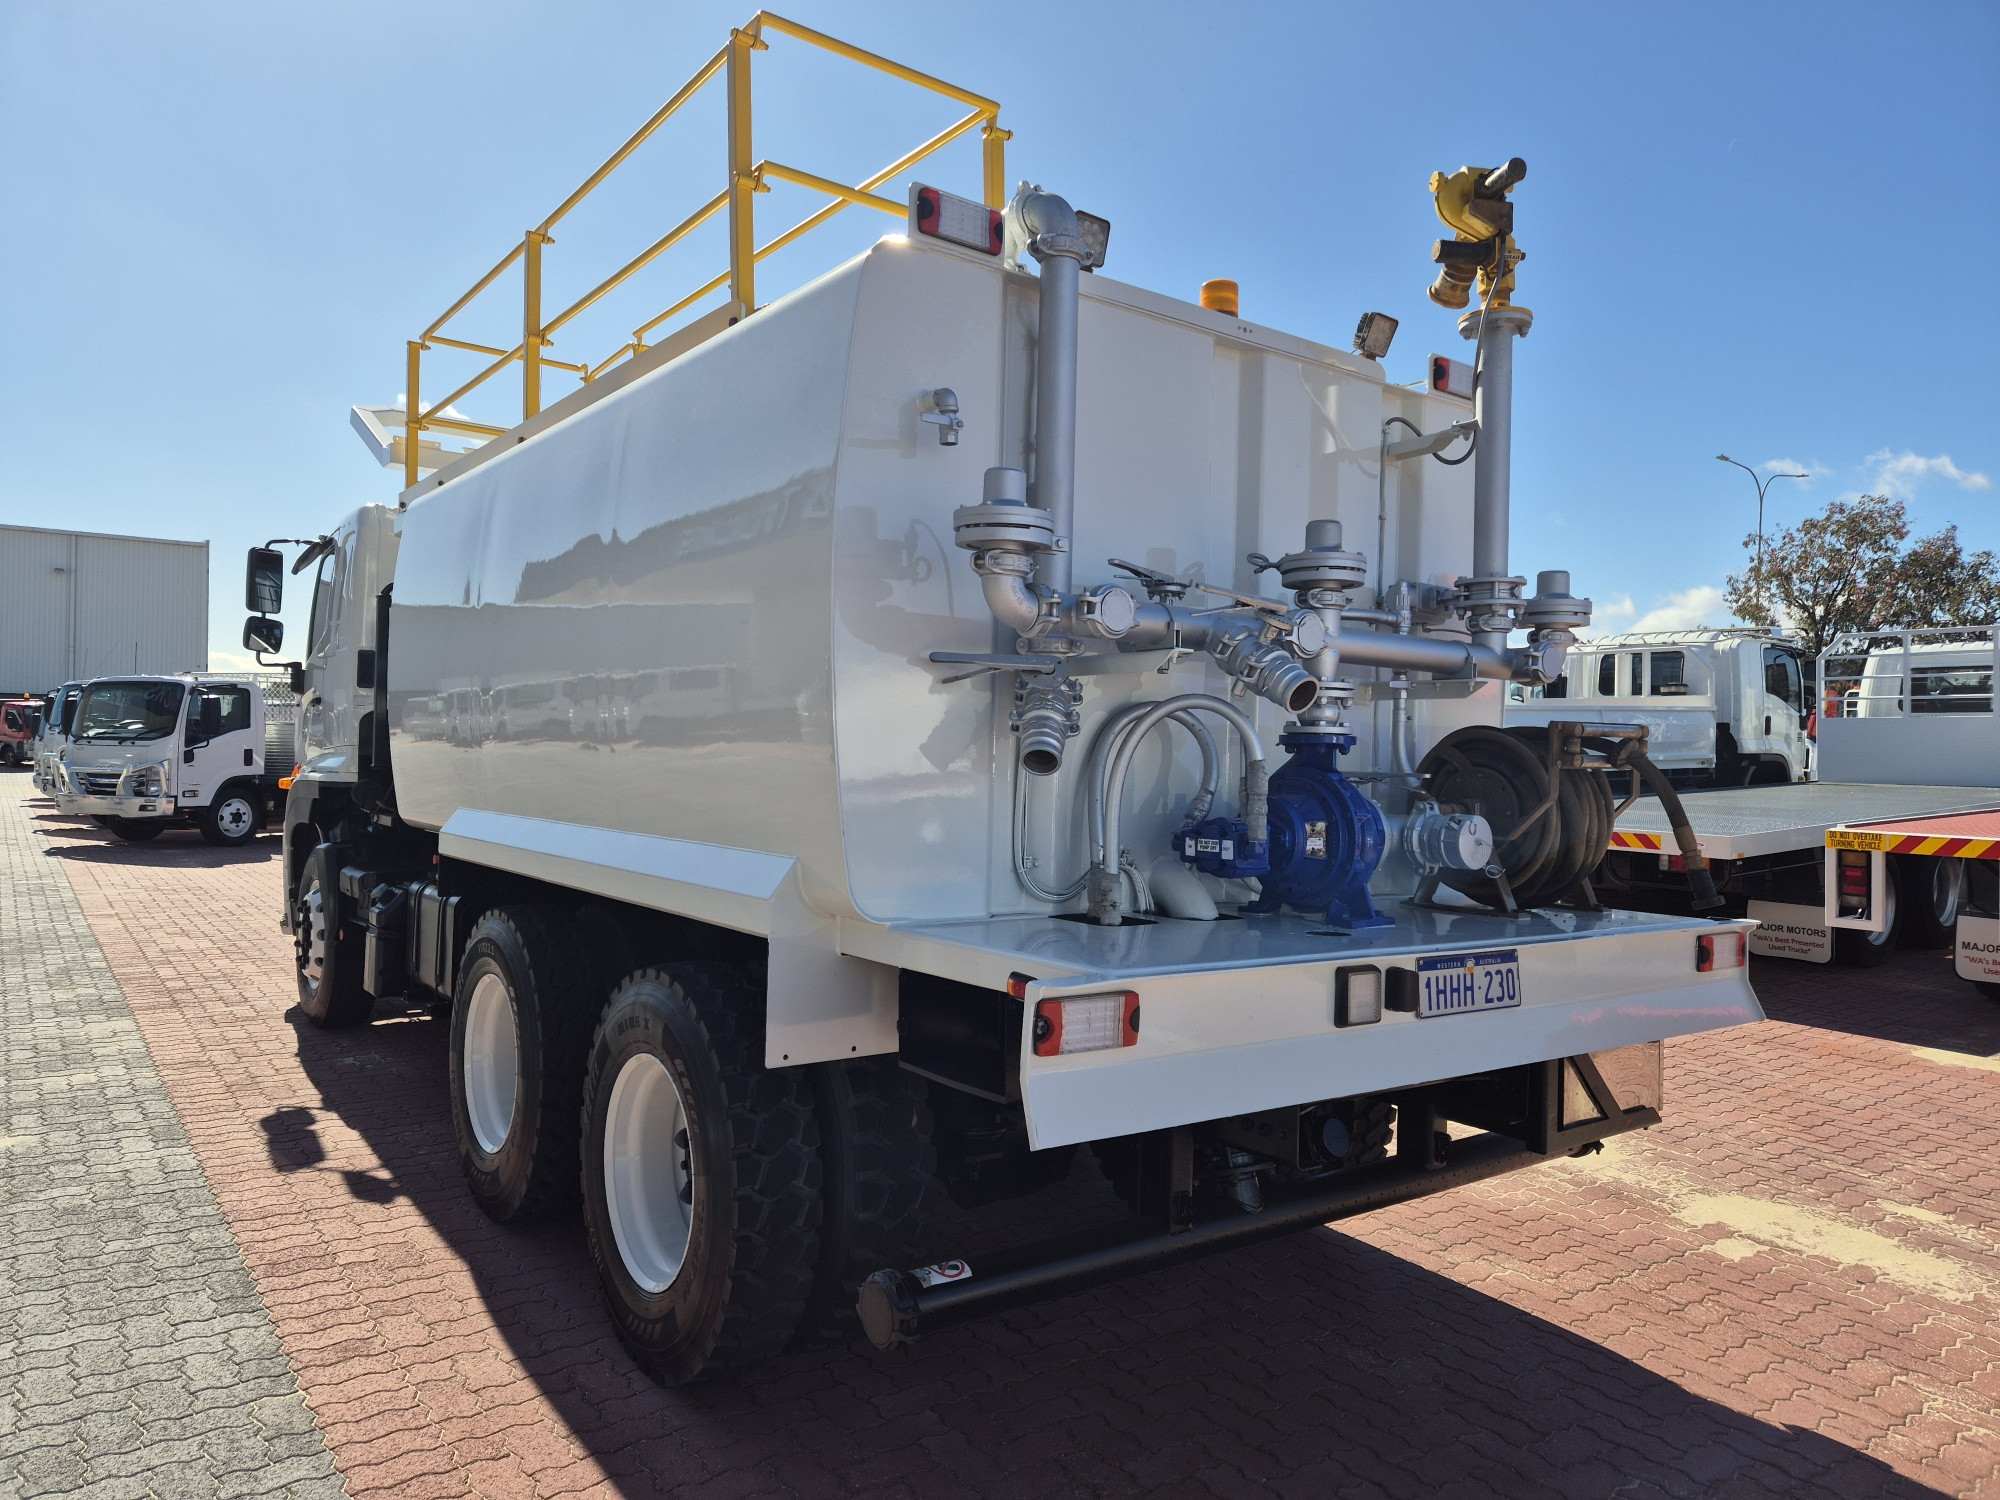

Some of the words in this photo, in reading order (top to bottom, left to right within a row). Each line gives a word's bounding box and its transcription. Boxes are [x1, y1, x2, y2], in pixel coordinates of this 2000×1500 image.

[1853, 832, 1882, 841] OVERTAKE
[1830, 839, 1855, 848] TURNING
[1857, 841, 1881, 850] VEHICLE
[1756, 923, 1784, 932] AJOR
[1787, 926, 1827, 938] MOTORS
[1775, 936, 1790, 944] Best
[1791, 938, 1825, 949] Presented
